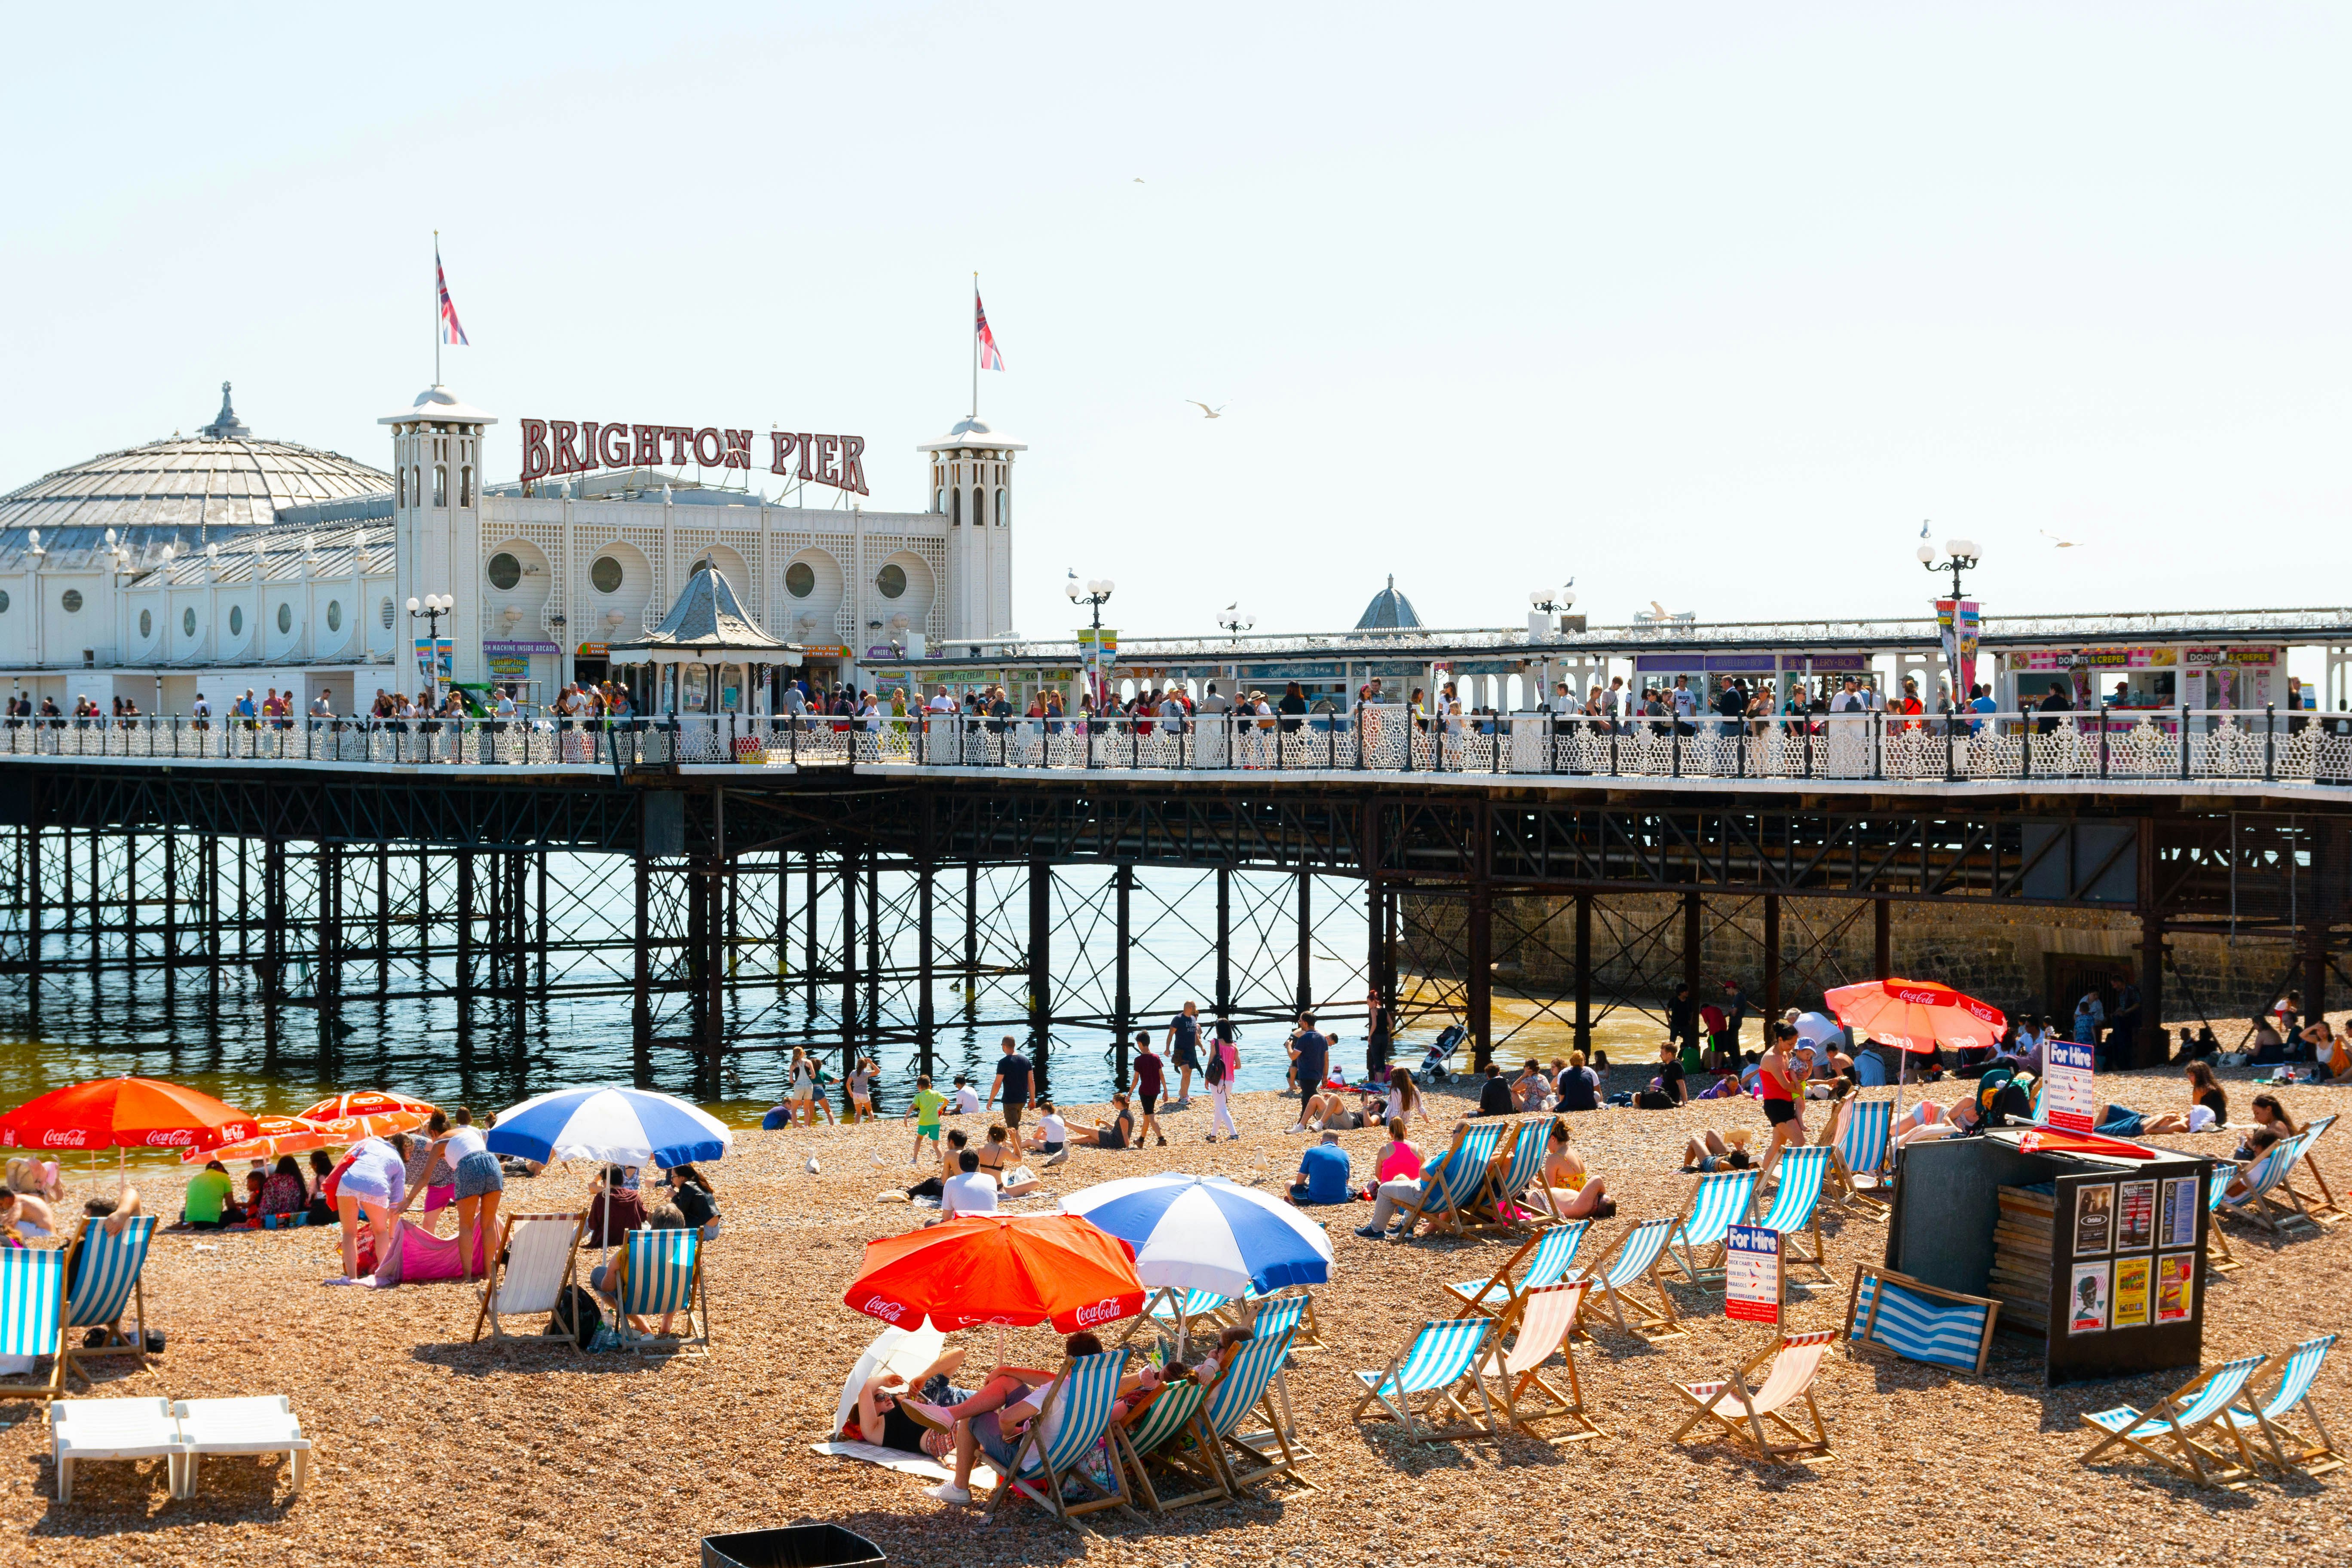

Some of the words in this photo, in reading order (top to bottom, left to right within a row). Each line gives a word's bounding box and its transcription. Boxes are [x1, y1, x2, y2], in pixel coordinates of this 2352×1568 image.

[520, 418, 753, 481] BRIGHTON
[770, 431, 869, 496] PIER
[1838, 658, 1856, 667] BOX
[2090, 655, 2096, 664] &
[1026, 671, 1056, 680] COFEE
[1268, 663, 1289, 677] Seafood
[1387, 663, 1409, 674] Sushi
[937, 672, 955, 681] COFFEE
[967, 671, 984, 680] CREAM
[1899, 989, 1936, 1004] Coca-Cola
[2051, 1043, 2068, 1063] For
[2070, 1046, 2092, 1067] Hire
[2050, 1104, 2075, 1112] WINDBREAKERS
[43, 1128, 87, 1146] Coca-Cola
[146, 1129, 195, 1146] Coca-Cola
[2165, 1197, 2174, 1225] MAY
[356, 1235, 374, 1246] packed
[1729, 1228, 1750, 1249] For
[1752, 1230, 1776, 1252] Hire
[2162, 1259, 2175, 1267] Pick
[1727, 1292, 1757, 1300] WINDBREAKERS
[864, 1295, 908, 1323] Coca-Cola
[1076, 1296, 1121, 1326] Coca-Cola
